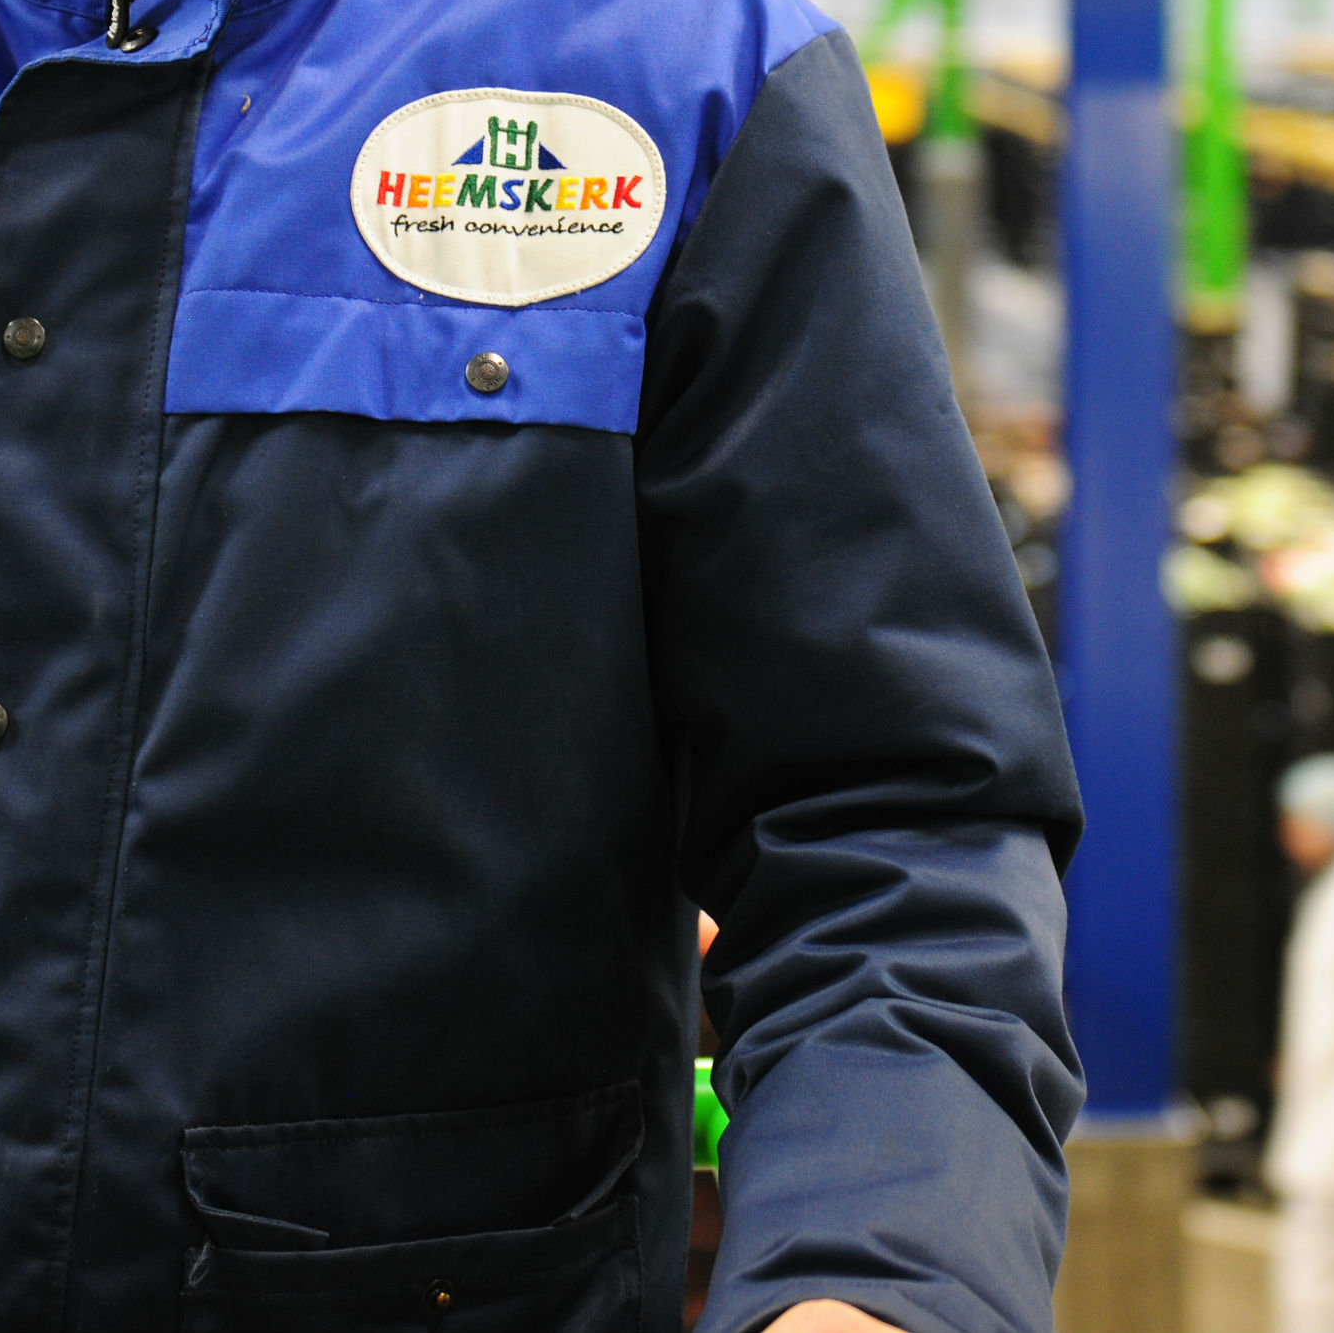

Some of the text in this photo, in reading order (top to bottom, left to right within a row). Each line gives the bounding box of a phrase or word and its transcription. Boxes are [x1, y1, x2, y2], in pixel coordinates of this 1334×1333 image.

[376, 170, 643, 212] HEEMSKERK
[390, 214, 625, 236] fresh convenience
